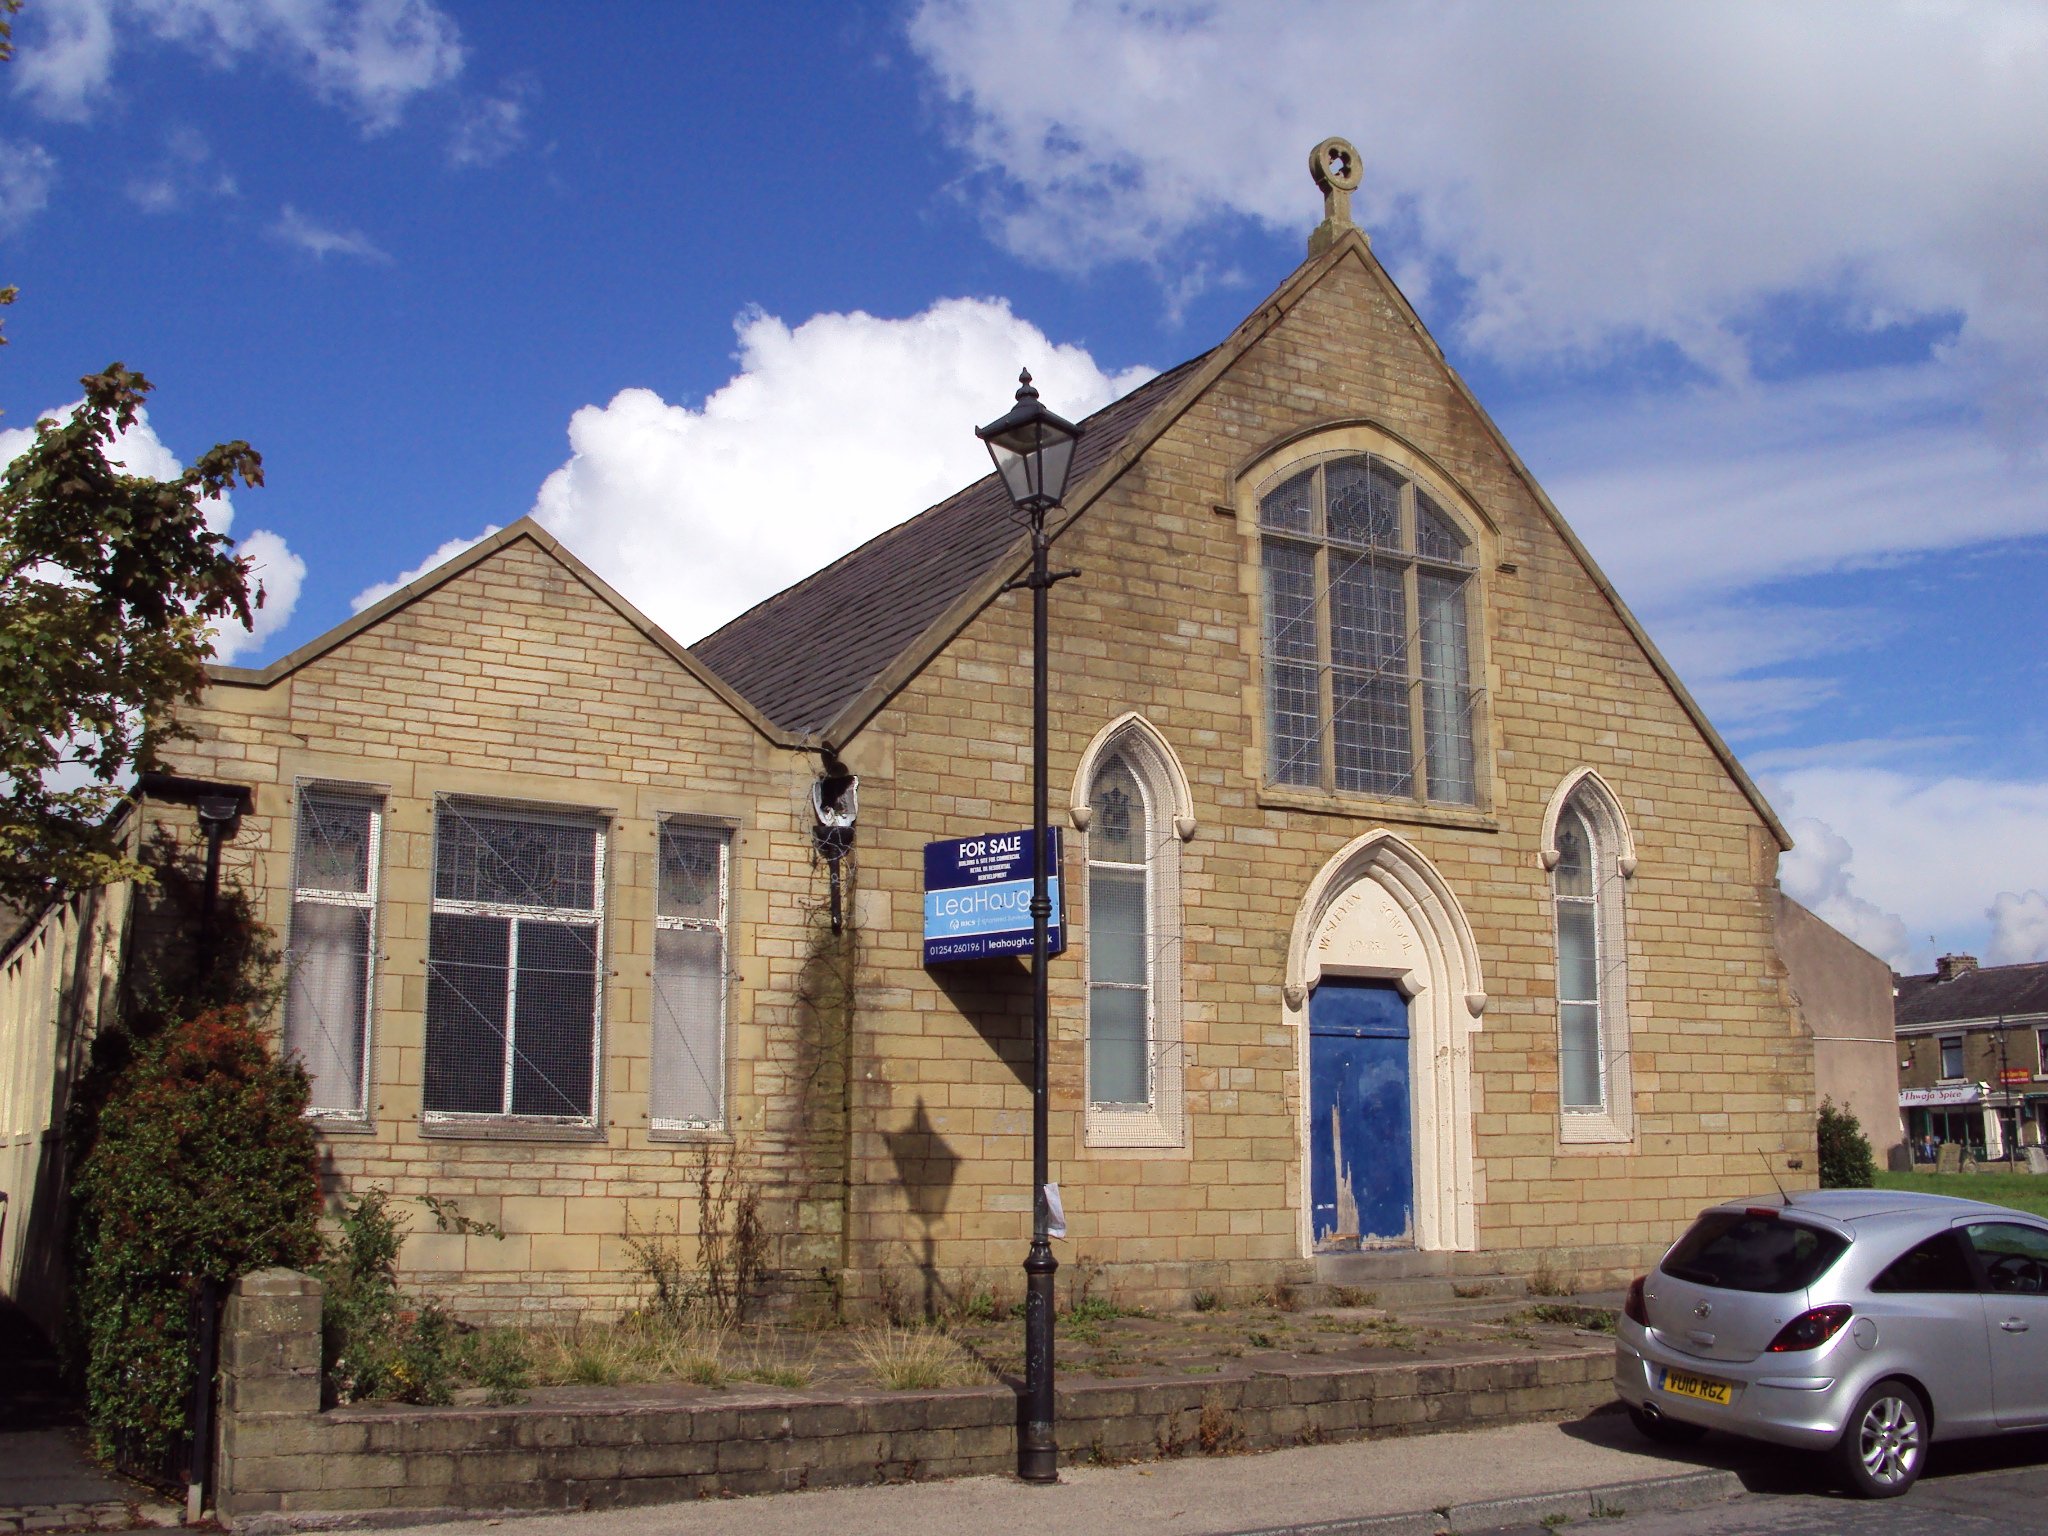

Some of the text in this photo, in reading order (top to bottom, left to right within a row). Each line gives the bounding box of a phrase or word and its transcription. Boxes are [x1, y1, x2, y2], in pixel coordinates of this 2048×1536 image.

[959, 836, 1021, 858] FOR SALE
[936, 887, 1034, 916] LeaHoug
[960, 919, 976, 927] RICS
[1379, 901, 1412, 956] SCHOOL
[930, 935, 1053, 956] 01254 260196 leahough.ck
[1939, 1090, 1962, 1100] Spice
[1670, 1373, 1727, 1401] VU10 RGZ
